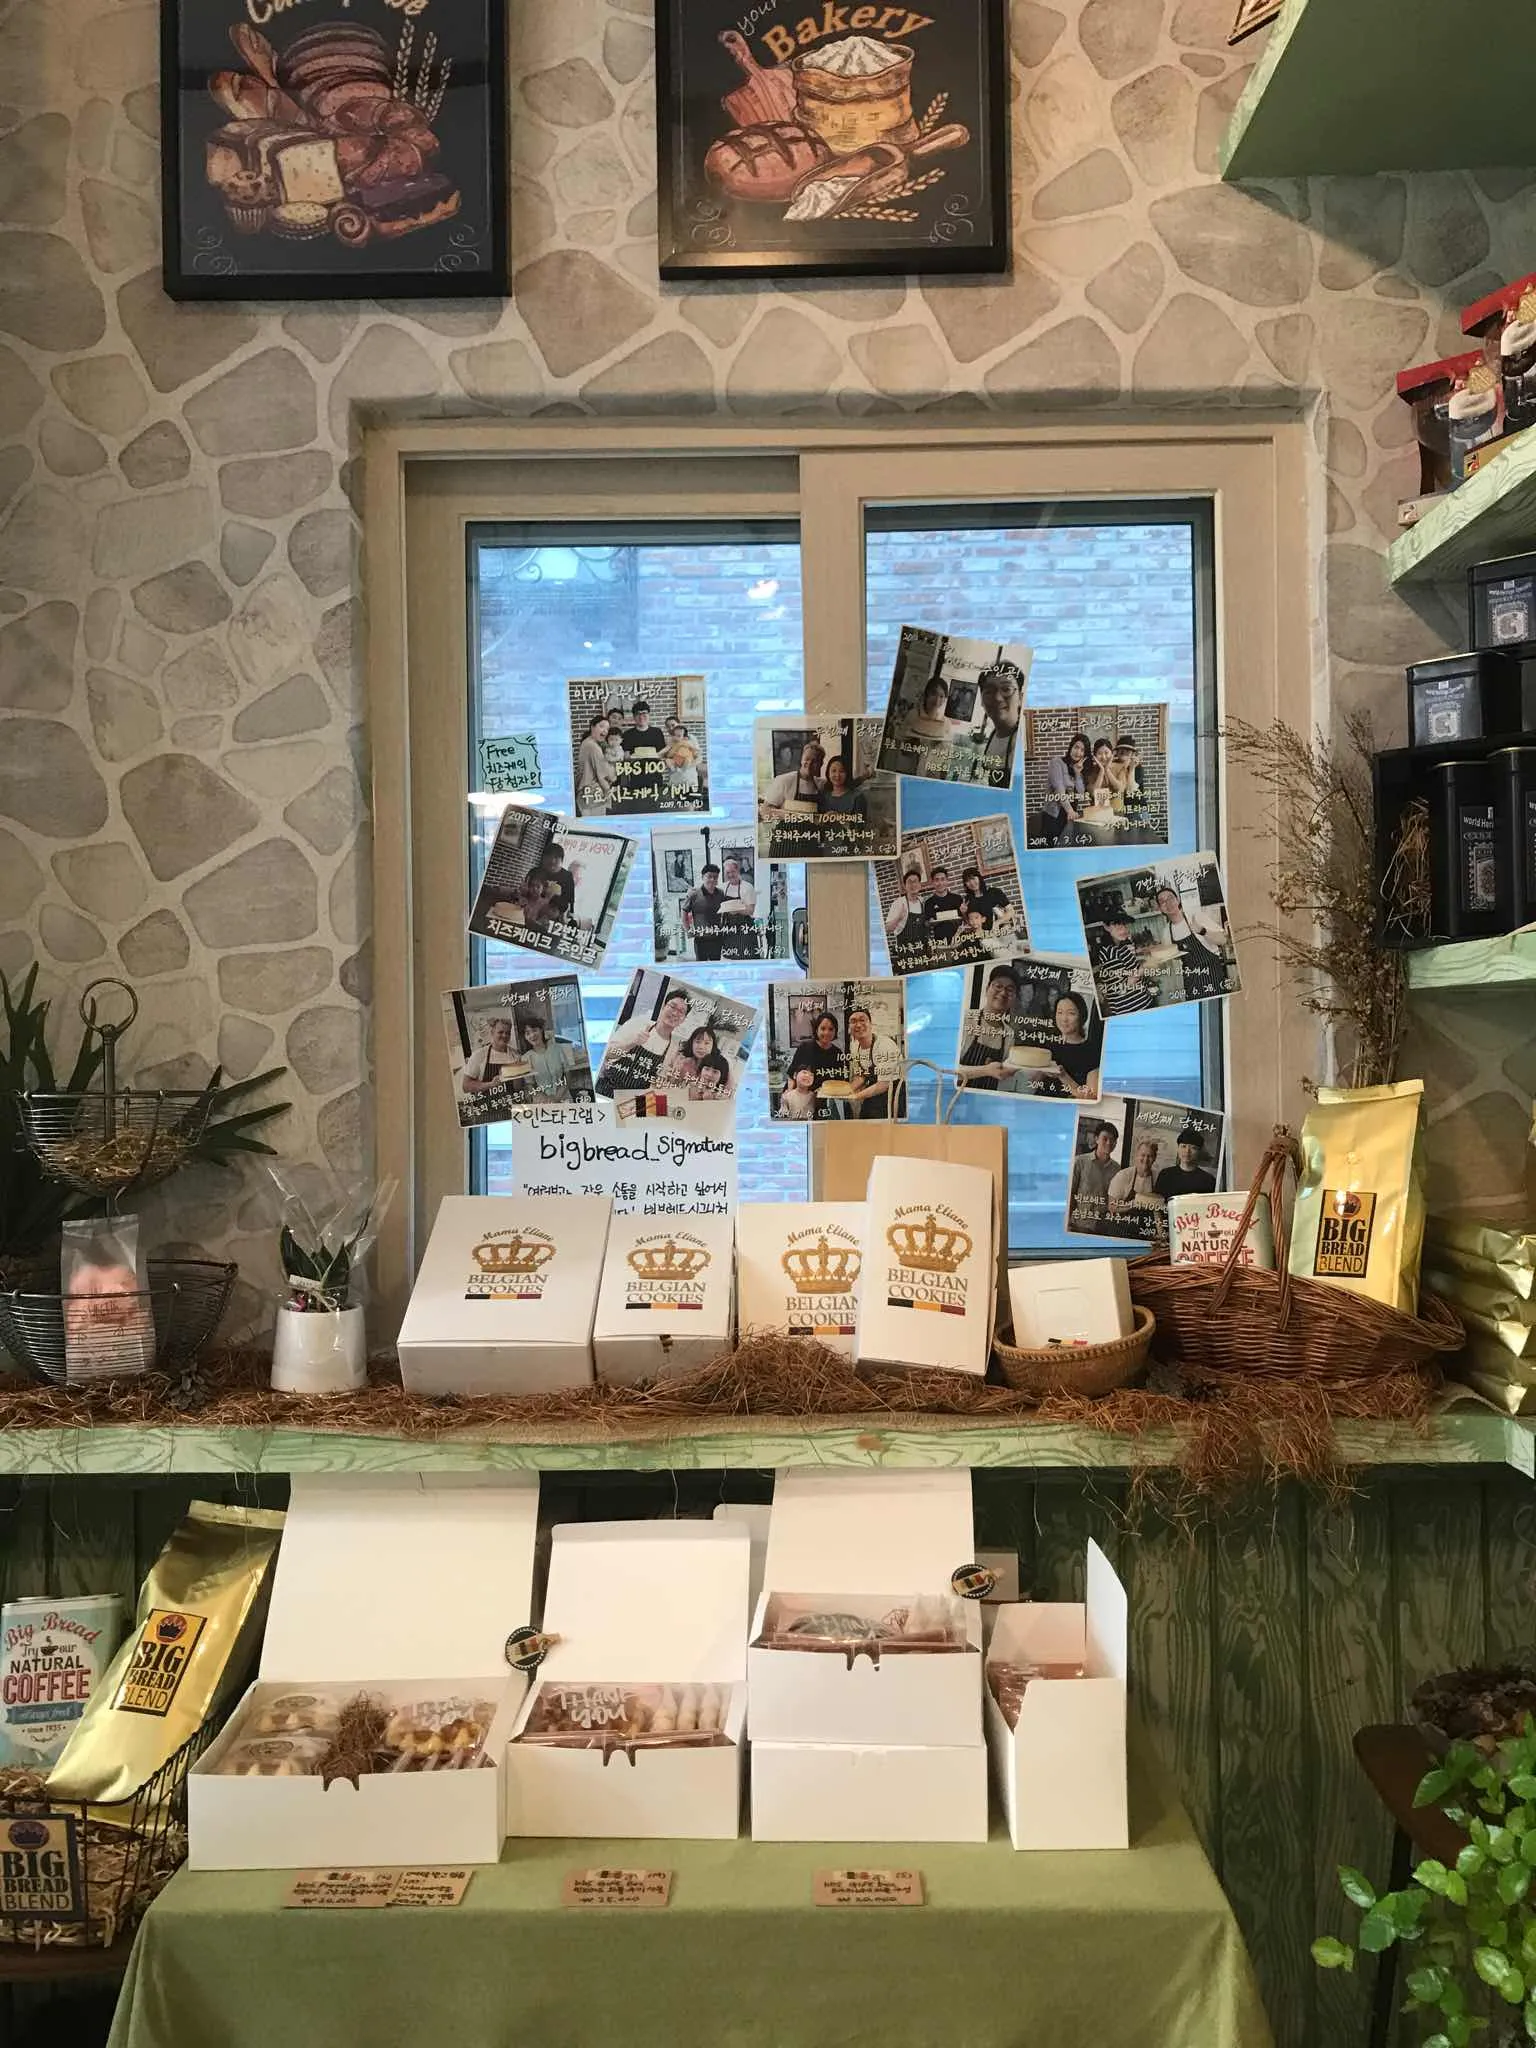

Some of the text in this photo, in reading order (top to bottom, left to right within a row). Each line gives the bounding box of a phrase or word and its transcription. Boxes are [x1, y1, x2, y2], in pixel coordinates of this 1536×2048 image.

[761, 1, 937, 64] Bakery
[486, 744, 516, 759] Free
[615, 761, 666, 776] BBS 100
[487, 919, 552, 949] 치즈케이크
[646, 1182, 688, 1197] 시작하고
[894, 1204, 969, 1230] Mama Eliane
[1174, 1212, 1201, 1234] Big
[481, 1226, 554, 1242] Mama Eliane
[787, 1223, 860, 1247] Mama Eliane
[1322, 1217, 1368, 1242] BIG
[633, 1231, 708, 1247] Mama Eliane
[1320, 1241, 1365, 1256] BREAD
[1318, 1255, 1363, 1273] BLEND
[467, 1274, 548, 1284] BELGIAN
[626, 1281, 706, 1293] BELGIAN
[888, 1268, 968, 1292] BELGIAN
[466, 1284, 544, 1294] COOKIES
[626, 1292, 704, 1303] COOKIES
[888, 1285, 966, 1307] COOKIES
[786, 1296, 859, 1311] BELGIAN
[788, 1312, 856, 1326] COOKIE
[5, 1611, 103, 1651] Big Bread
[20, 1642, 77, 1658] Try our
[128, 1641, 186, 1674] BIG
[10, 1655, 85, 1674] NATURAL
[2, 1668, 92, 1705] COFFEE
[127, 1668, 176, 1691] BREAD
[2, 1851, 65, 1878] BIG
[4, 1878, 69, 1893] BREAD
[5, 1894, 70, 1910] BLEND
